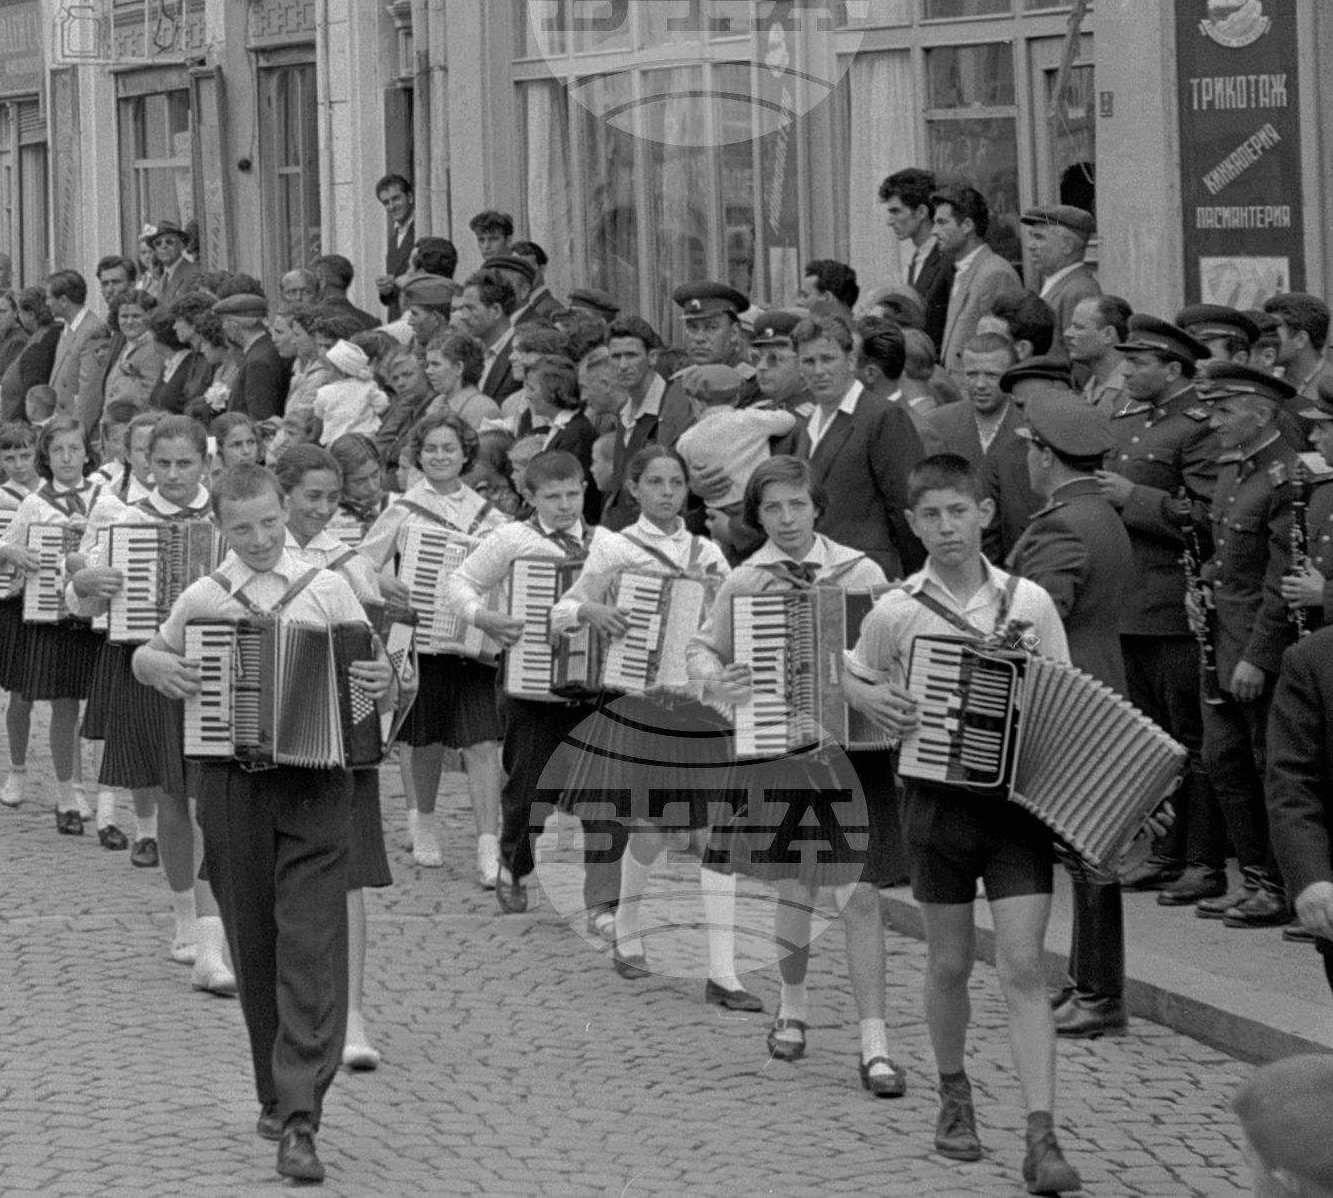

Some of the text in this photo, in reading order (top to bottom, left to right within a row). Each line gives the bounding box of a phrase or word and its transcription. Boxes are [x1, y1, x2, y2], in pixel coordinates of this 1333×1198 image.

[1190, 73, 1288, 110] ТРИКОТАЖ
[1202, 122, 1282, 195] КИНКАЛЕРИЯ
[1196, 205, 1291, 229] ПАСМАНТЕРИЯ
